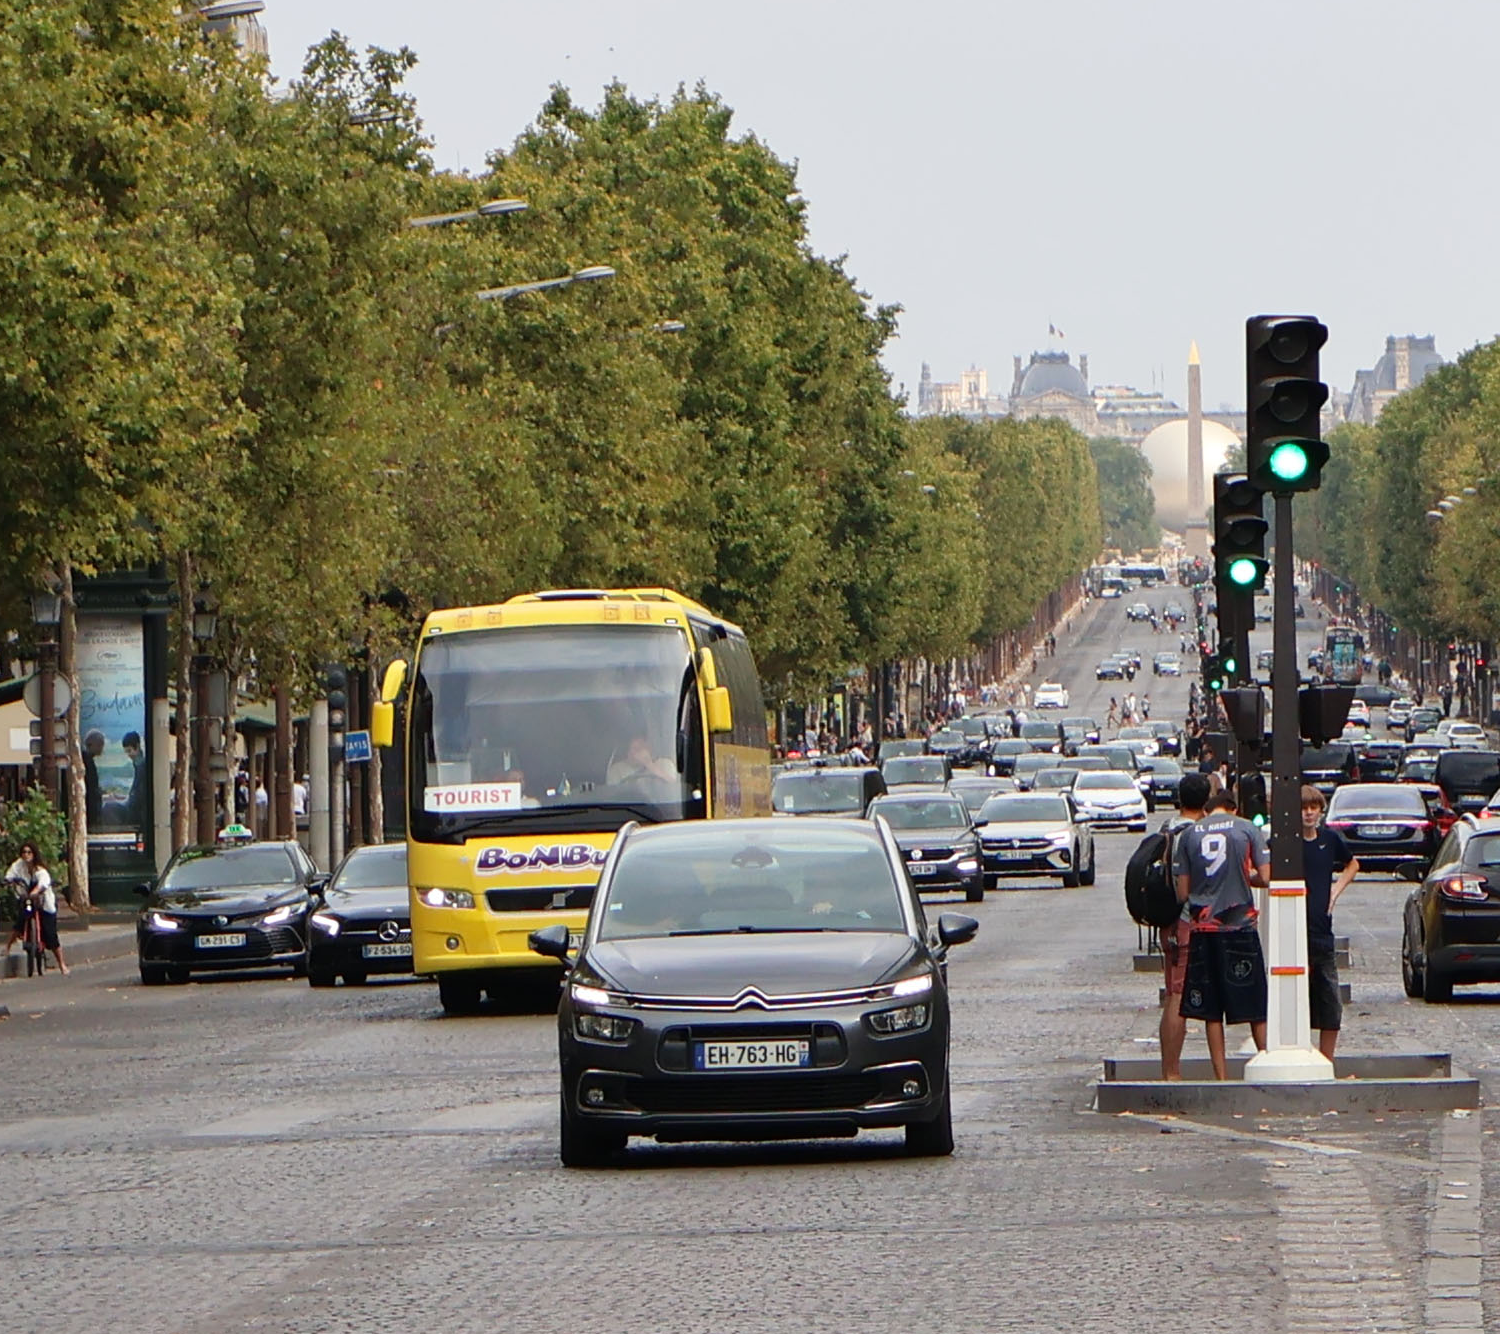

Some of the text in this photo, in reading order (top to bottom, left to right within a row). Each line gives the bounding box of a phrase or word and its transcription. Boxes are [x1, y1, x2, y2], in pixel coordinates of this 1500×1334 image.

[434, 788, 512, 806] TOURIST
[1202, 833, 1227, 876] 9
[708, 1045, 796, 1064] EH-763-HG
